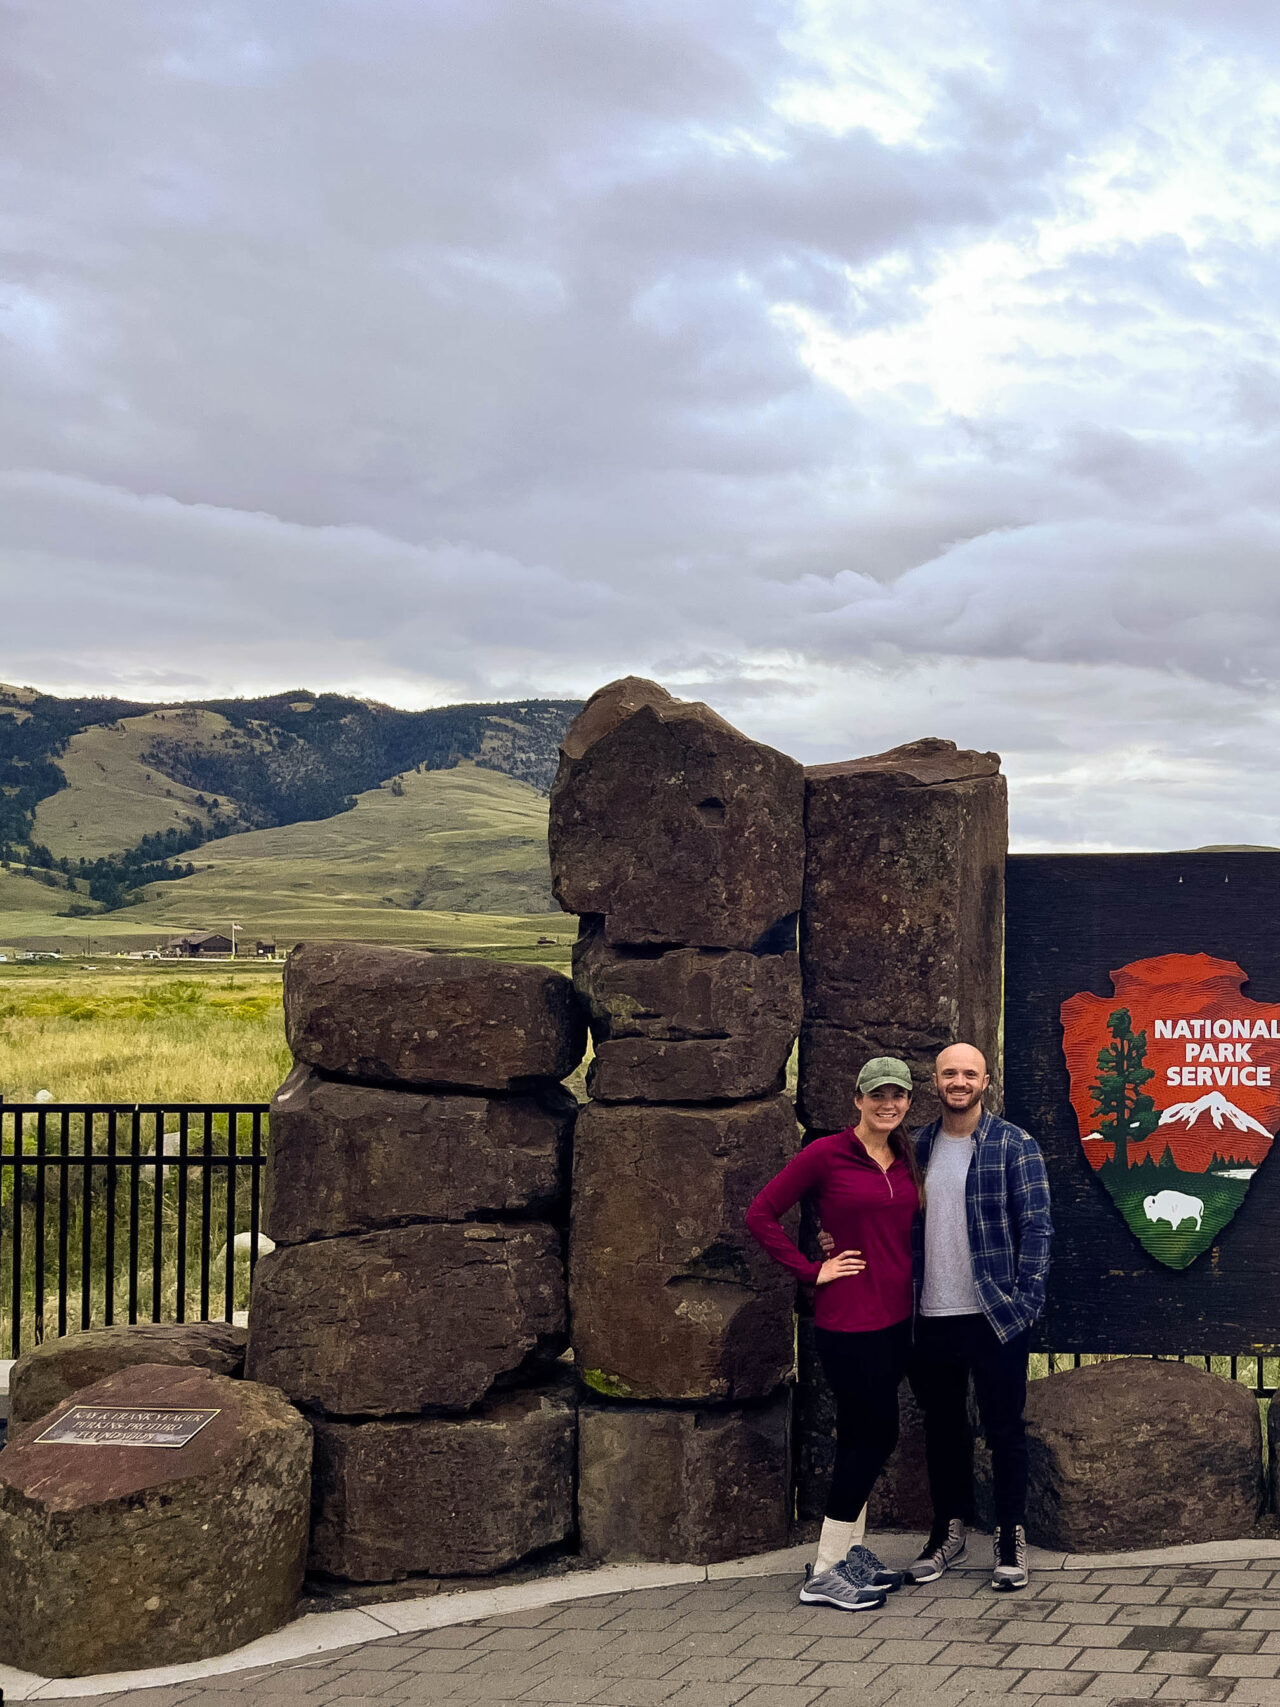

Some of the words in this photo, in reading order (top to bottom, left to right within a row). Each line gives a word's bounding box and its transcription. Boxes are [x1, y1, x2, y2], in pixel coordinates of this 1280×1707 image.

[1185, 1042, 1253, 1063] PARK
[1166, 1066, 1271, 1087] SERVICE
[110, 1412, 154, 1421] FRANK
[155, 1413, 204, 1422] YEAGER
[76, 1431, 155, 1440] FOUNDATION
